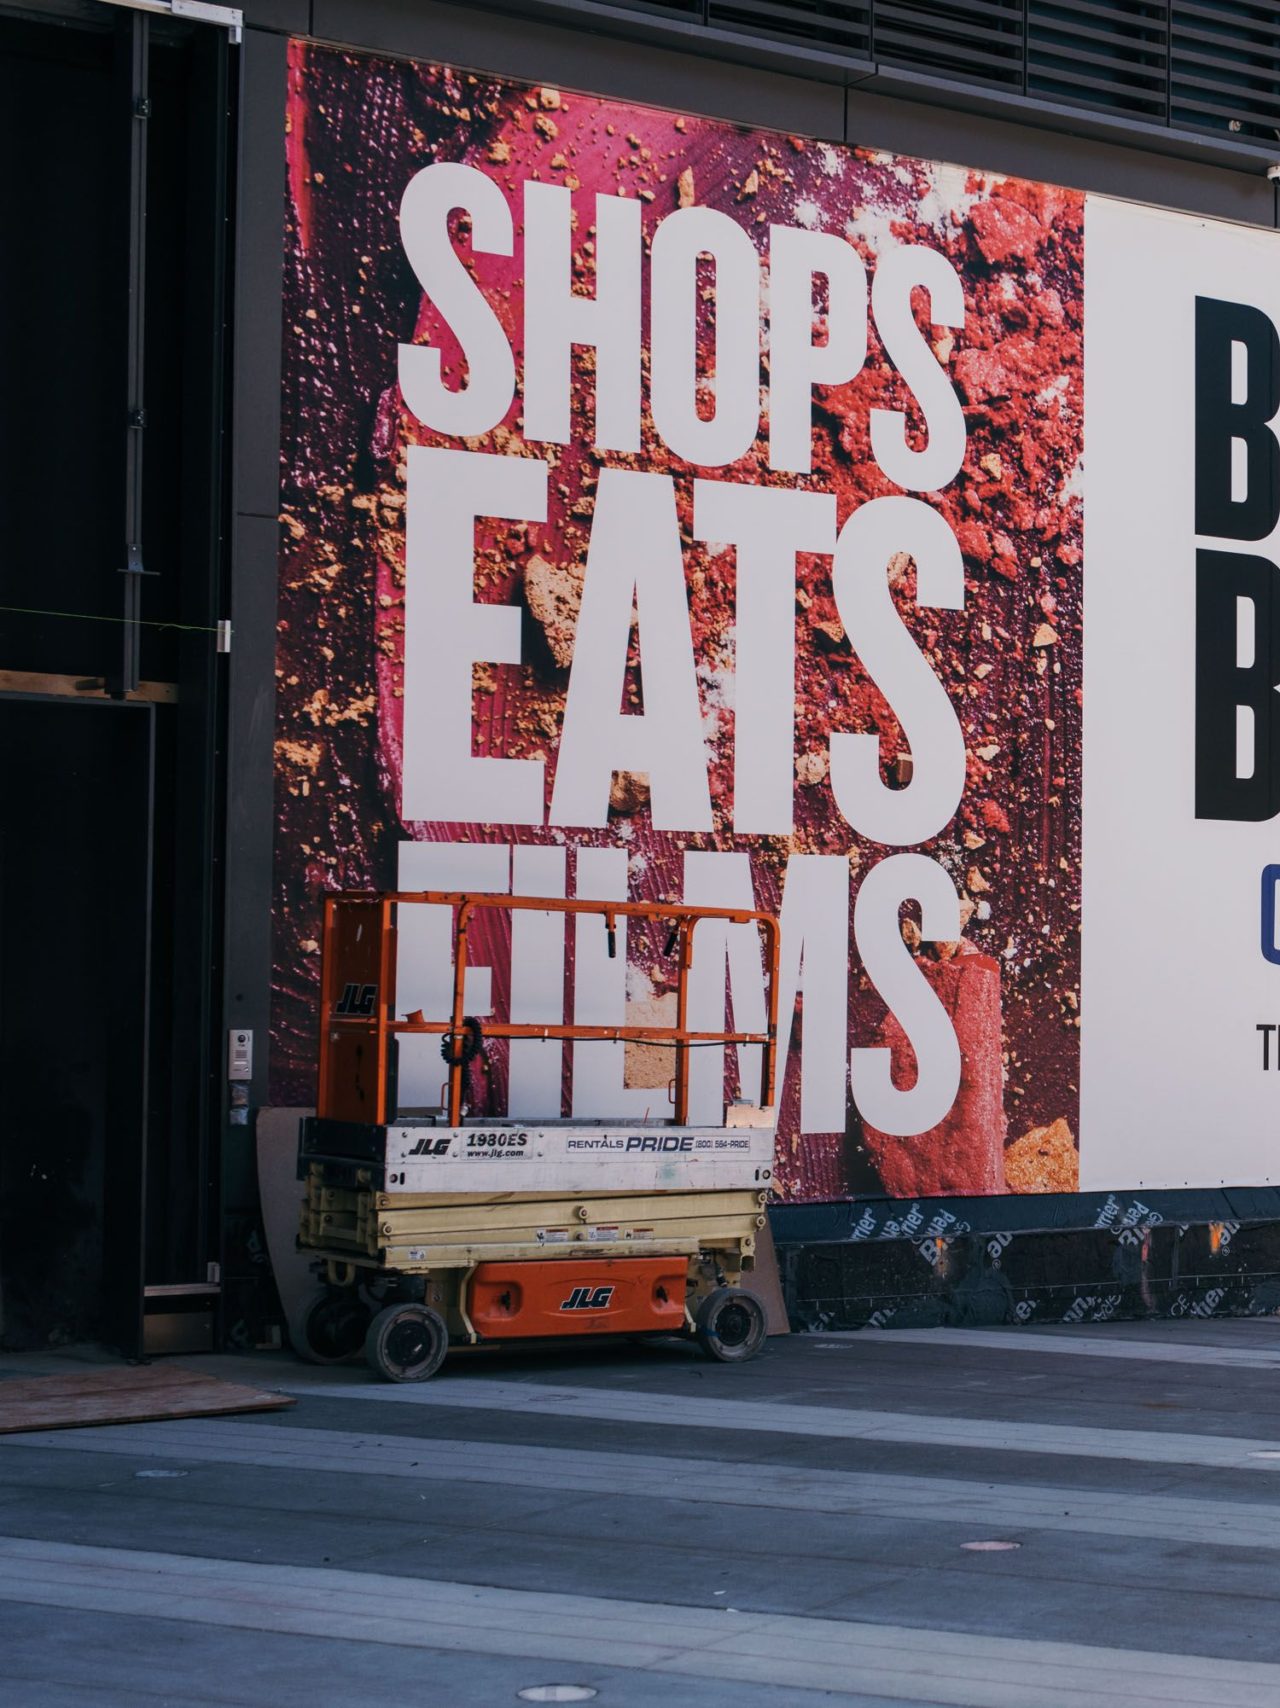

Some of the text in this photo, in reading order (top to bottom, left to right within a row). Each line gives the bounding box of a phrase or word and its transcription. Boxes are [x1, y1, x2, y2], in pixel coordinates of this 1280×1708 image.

[398, 162, 967, 492] SHOPS
[402, 445, 966, 847] EATS
[335, 983, 378, 1016] JLG
[397, 840, 961, 1137] FILMS
[408, 1139, 452, 1155] JLG
[467, 1149, 524, 1158] www.jlg.com
[568, 1140, 624, 1149] RENTALS
[625, 1137, 695, 1152] PRIDE
[560, 1286, 615, 1310] JLG
